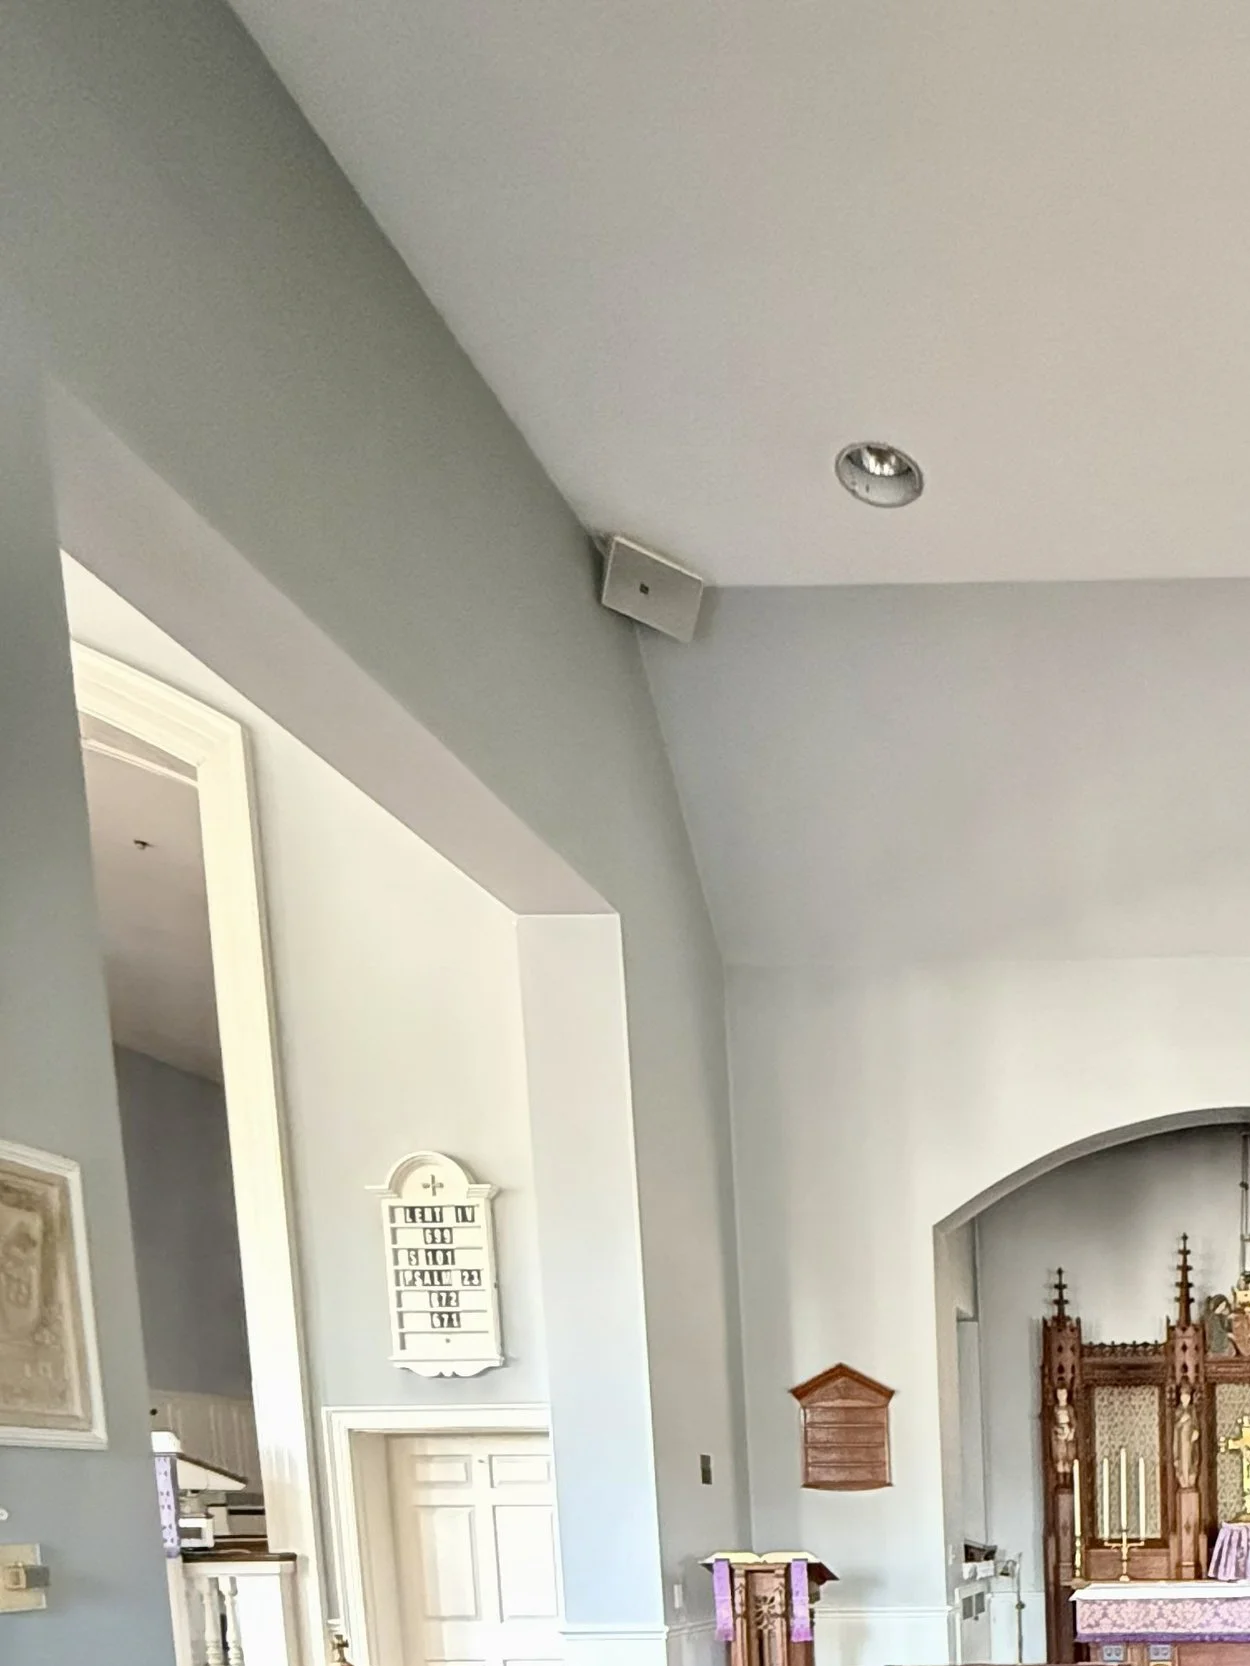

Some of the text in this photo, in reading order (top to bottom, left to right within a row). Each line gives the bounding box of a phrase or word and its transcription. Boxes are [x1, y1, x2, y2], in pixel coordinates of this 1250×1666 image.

[405, 1206, 473, 1223] LENT IV
[425, 1228, 452, 1244] 699
[408, 1250, 453, 1265] S 101
[404, 1270, 479, 1286] PSALM 23
[432, 1312, 459, 1328] 671
